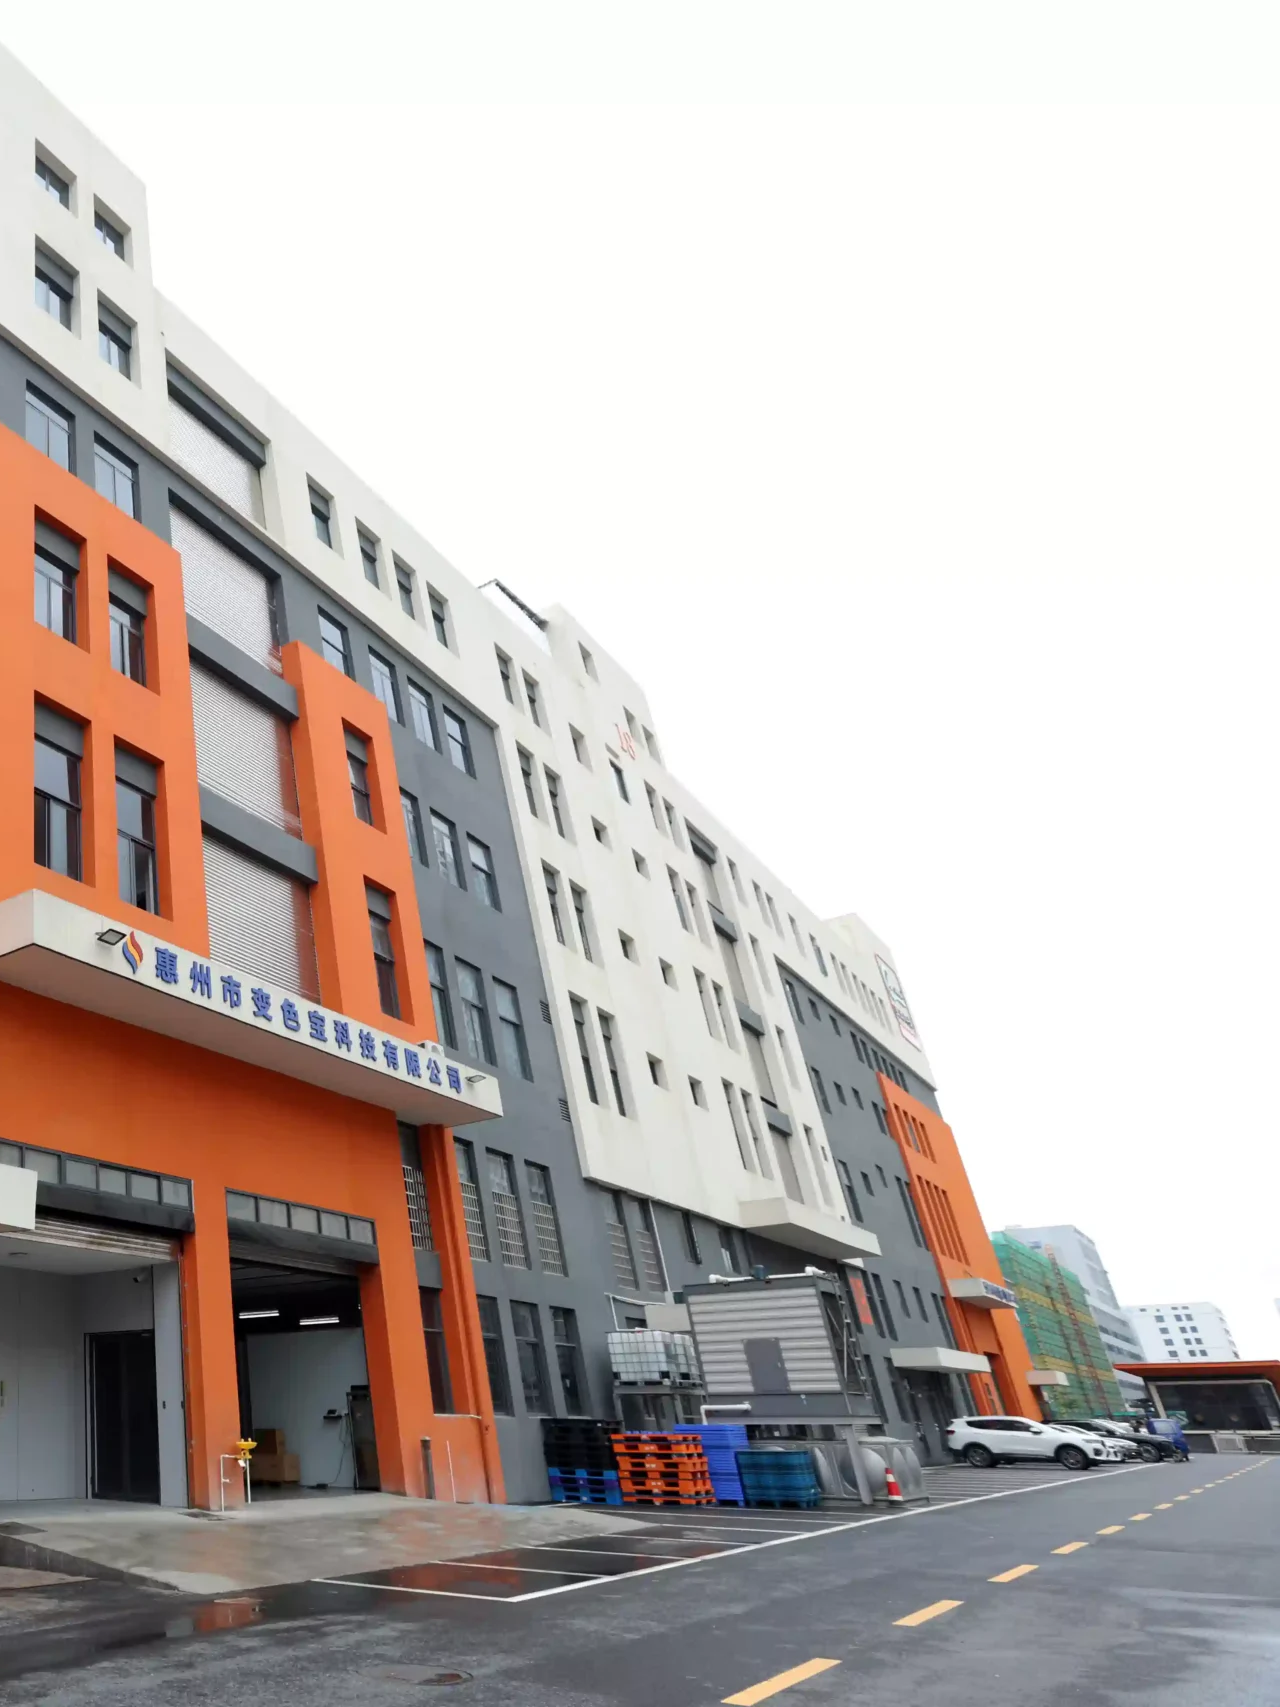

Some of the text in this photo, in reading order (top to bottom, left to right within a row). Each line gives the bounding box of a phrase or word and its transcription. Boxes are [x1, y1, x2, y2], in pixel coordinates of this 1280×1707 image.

[155, 946, 462, 1094] 惠州市变色宝科技有限公司
